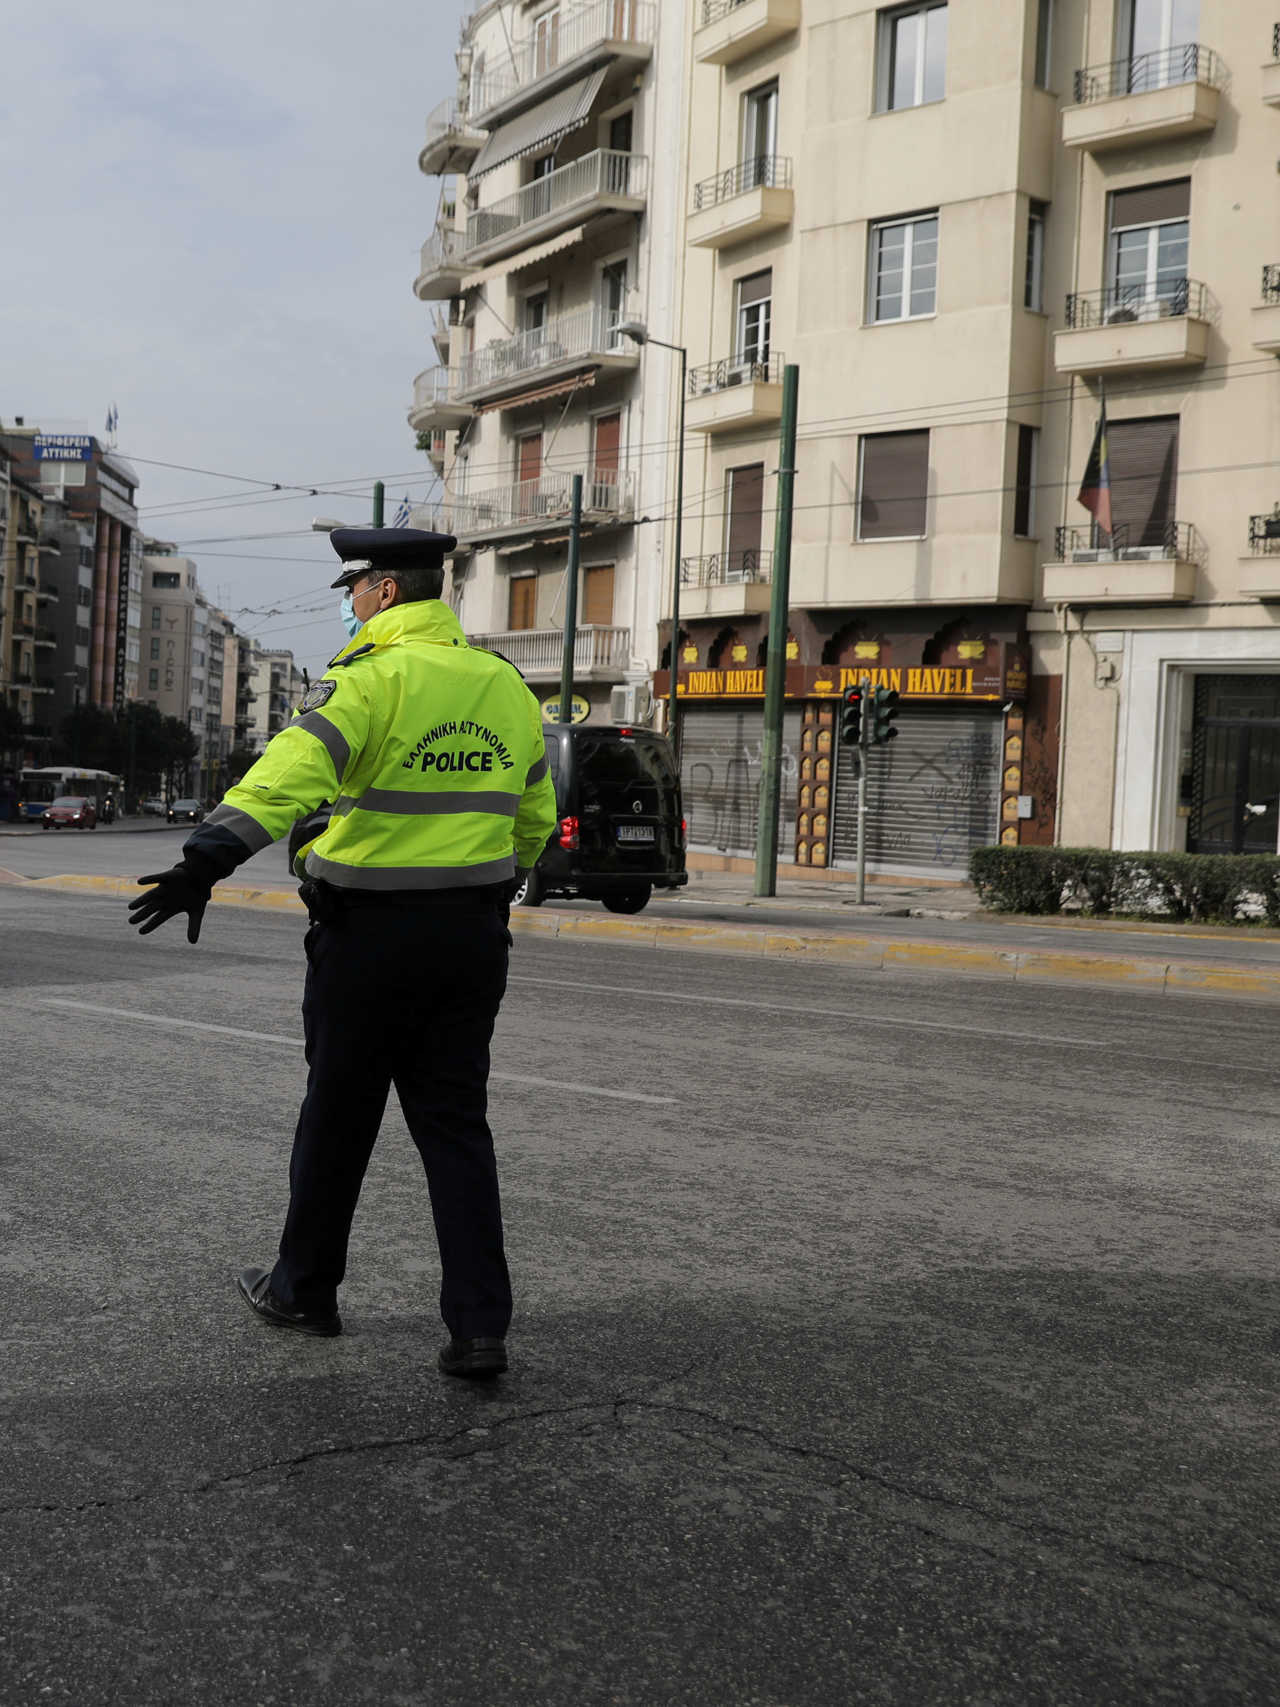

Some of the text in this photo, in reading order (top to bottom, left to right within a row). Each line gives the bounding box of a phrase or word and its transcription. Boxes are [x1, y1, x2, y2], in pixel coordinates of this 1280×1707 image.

[34, 436, 90, 447] ΠΕΡΙΦΕΡΕΙΑ
[41, 447, 82, 459] ΑΤΤΙΚΗΣ
[688, 669, 764, 693] INDIAN HAVELI
[839, 667, 975, 693] INDIAN HAVELI
[402, 721, 457, 770] ΕΛΛΗΝΙΚΗ
[421, 751, 493, 773] POLICE
